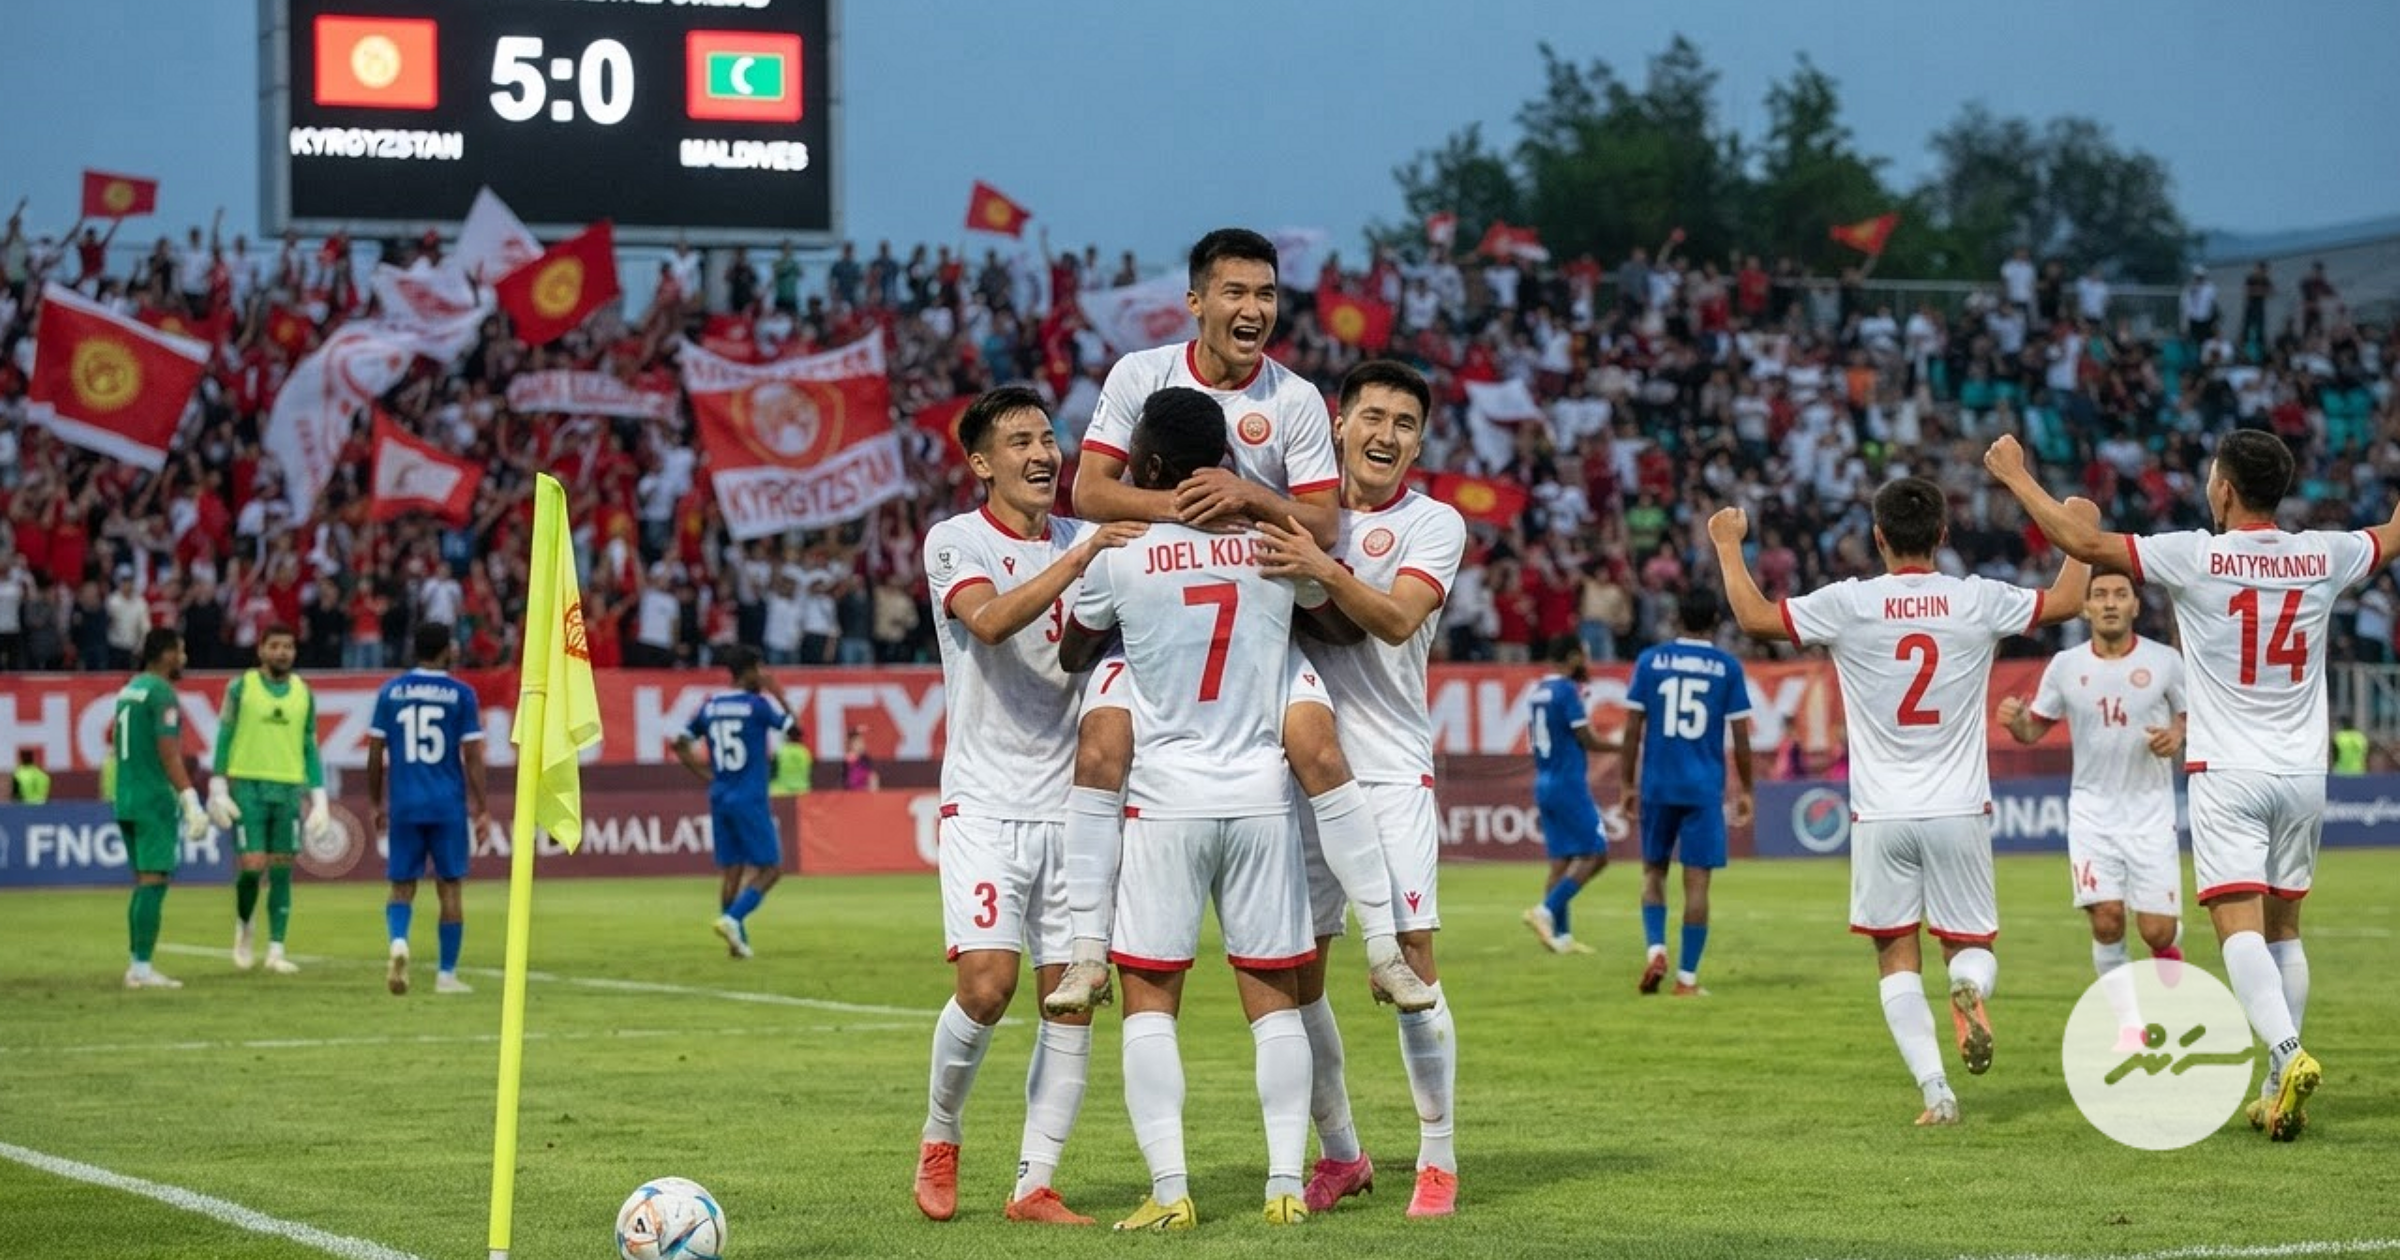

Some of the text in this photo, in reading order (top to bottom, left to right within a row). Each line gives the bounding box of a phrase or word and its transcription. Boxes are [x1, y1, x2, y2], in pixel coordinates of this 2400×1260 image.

[489, 35, 635, 125] 5:0
[289, 126, 464, 160] KYRGYZSTAN
[1145, 541, 1204, 575] JOEL
[1884, 594, 1949, 620] KICHIN
[1183, 582, 1239, 703] 7
[2228, 586, 2309, 686] 14
[1099, 661, 1124, 695] 7
[1895, 632, 1940, 727] 2
[396, 704, 446, 765] 15
[1656, 675, 1711, 740] 15
[2097, 696, 2128, 728] 14
[708, 719, 748, 773] 15
[974, 882, 998, 929] 3
